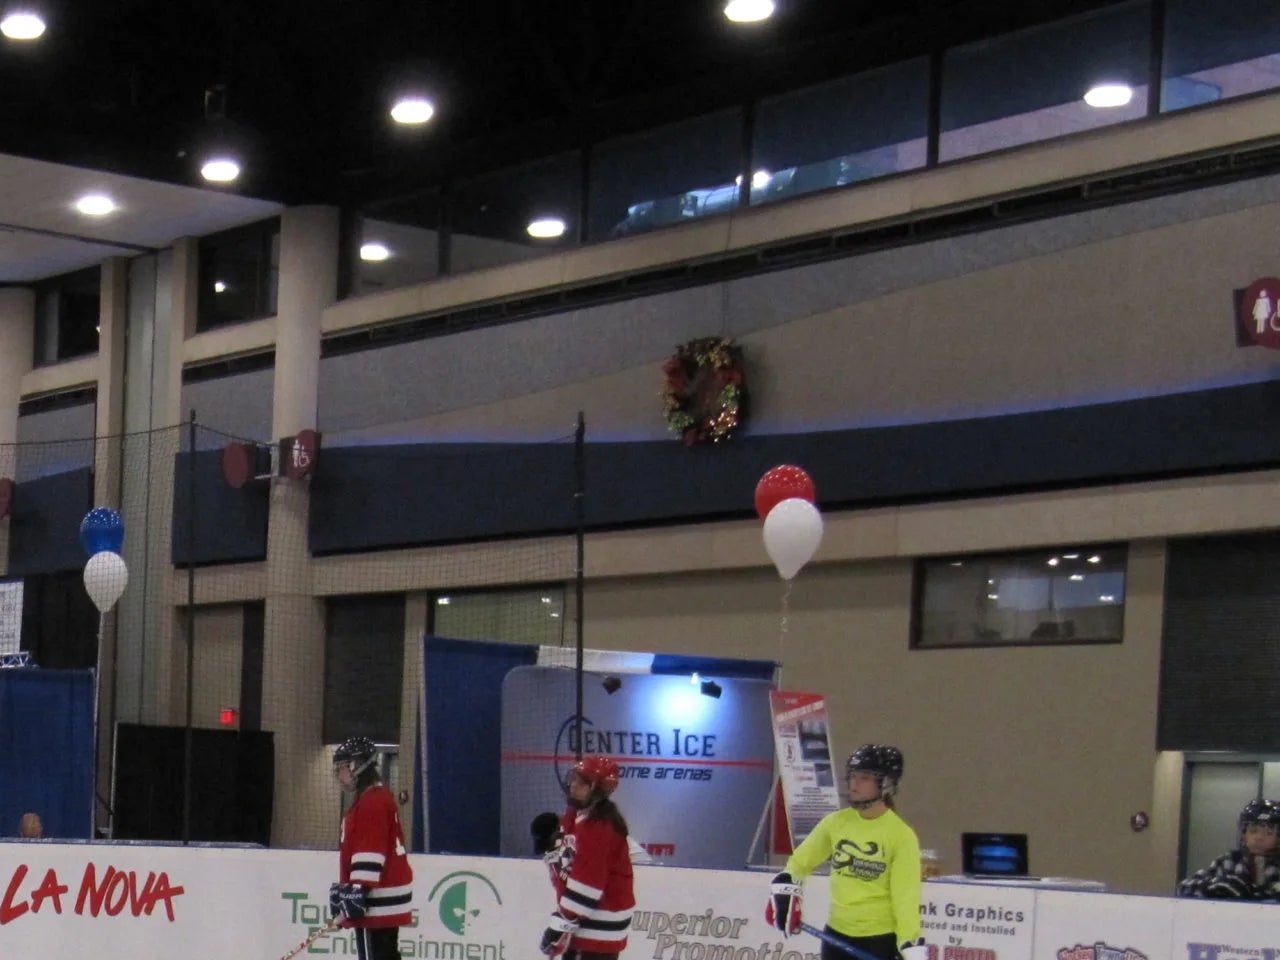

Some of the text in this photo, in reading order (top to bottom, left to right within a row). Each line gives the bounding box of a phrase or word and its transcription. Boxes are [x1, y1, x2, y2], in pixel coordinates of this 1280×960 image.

[672, 728, 717, 757] ICE
[619, 765, 713, 782] ome arenas
[73, 861, 185, 923] NOVA
[945, 903, 1025, 923] Graphics
[631, 908, 748, 940] uperior
[950, 922, 968, 932] and
[949, 936, 963, 946] by
[1222, 944, 1260, 957] Western
